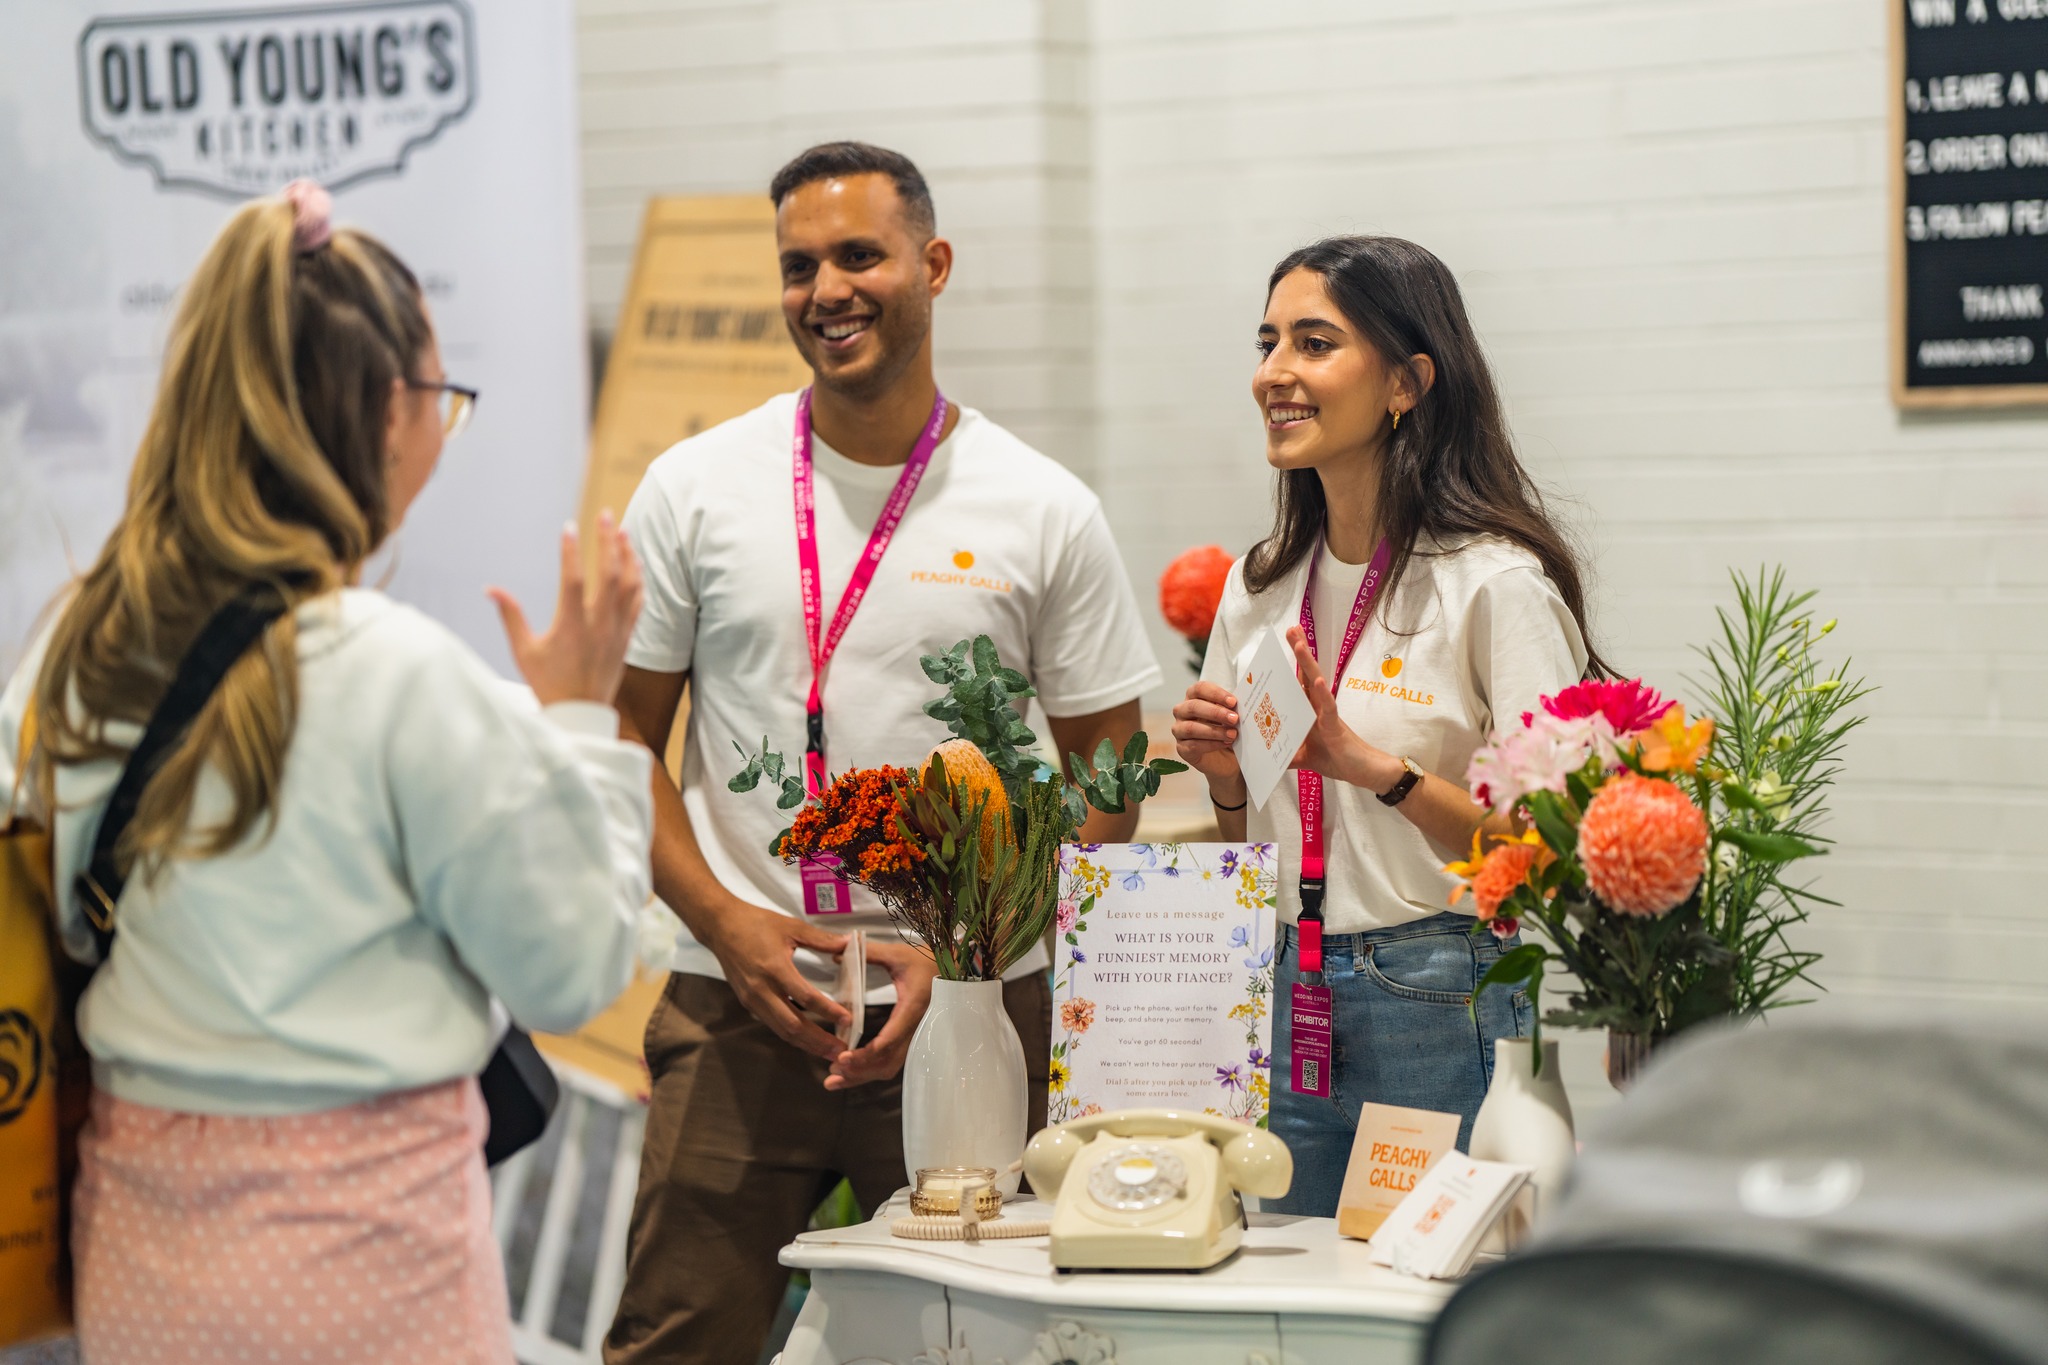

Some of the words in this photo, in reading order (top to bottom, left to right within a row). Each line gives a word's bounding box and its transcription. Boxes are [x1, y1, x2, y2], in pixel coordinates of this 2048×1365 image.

[101, 39, 199, 116] OLD
[219, 18, 457, 105] YOUNG'S
[2007, 71, 2030, 106] A
[196, 112, 362, 160] KITCHEN
[1960, 283, 2044, 322] THANK
[911, 571, 967, 585] PEACHY
[969, 576, 1012, 593] CALLS
[1354, 568, 1379, 616] EXPOS
[1345, 677, 1389, 695] PEACHY
[1389, 686, 1435, 706] CALLS
[1305, 777, 1318, 842] WEDDING
[1107, 910, 1142, 919] Leave
[1146, 911, 1159, 919] us
[1163, 911, 1170, 919] a
[1173, 911, 1225, 921] message
[1115, 933, 1156, 943] WHAT
[1160, 933, 1172, 943] IS
[1176, 933, 1215, 943] YOUR
[1097, 953, 1165, 963] FUNNIEST
[1169, 953, 1231, 963] MEMORY
[1094, 973, 1130, 983] WITH
[1135, 973, 1173, 983] YOUR
[1177, 973, 1233, 983] FIANCE?
[1105, 1016, 1126, 1024] beep,
[1147, 1005, 1172, 1014] phone,
[1294, 1013, 1329, 1028] EXHIBITOR
[1144, 1038, 1156, 1046] got
[1168, 1078, 1185, 1087] pick
[1370, 1142, 1431, 1169] PEACHY
[1369, 1168, 1416, 1193] CALLS
